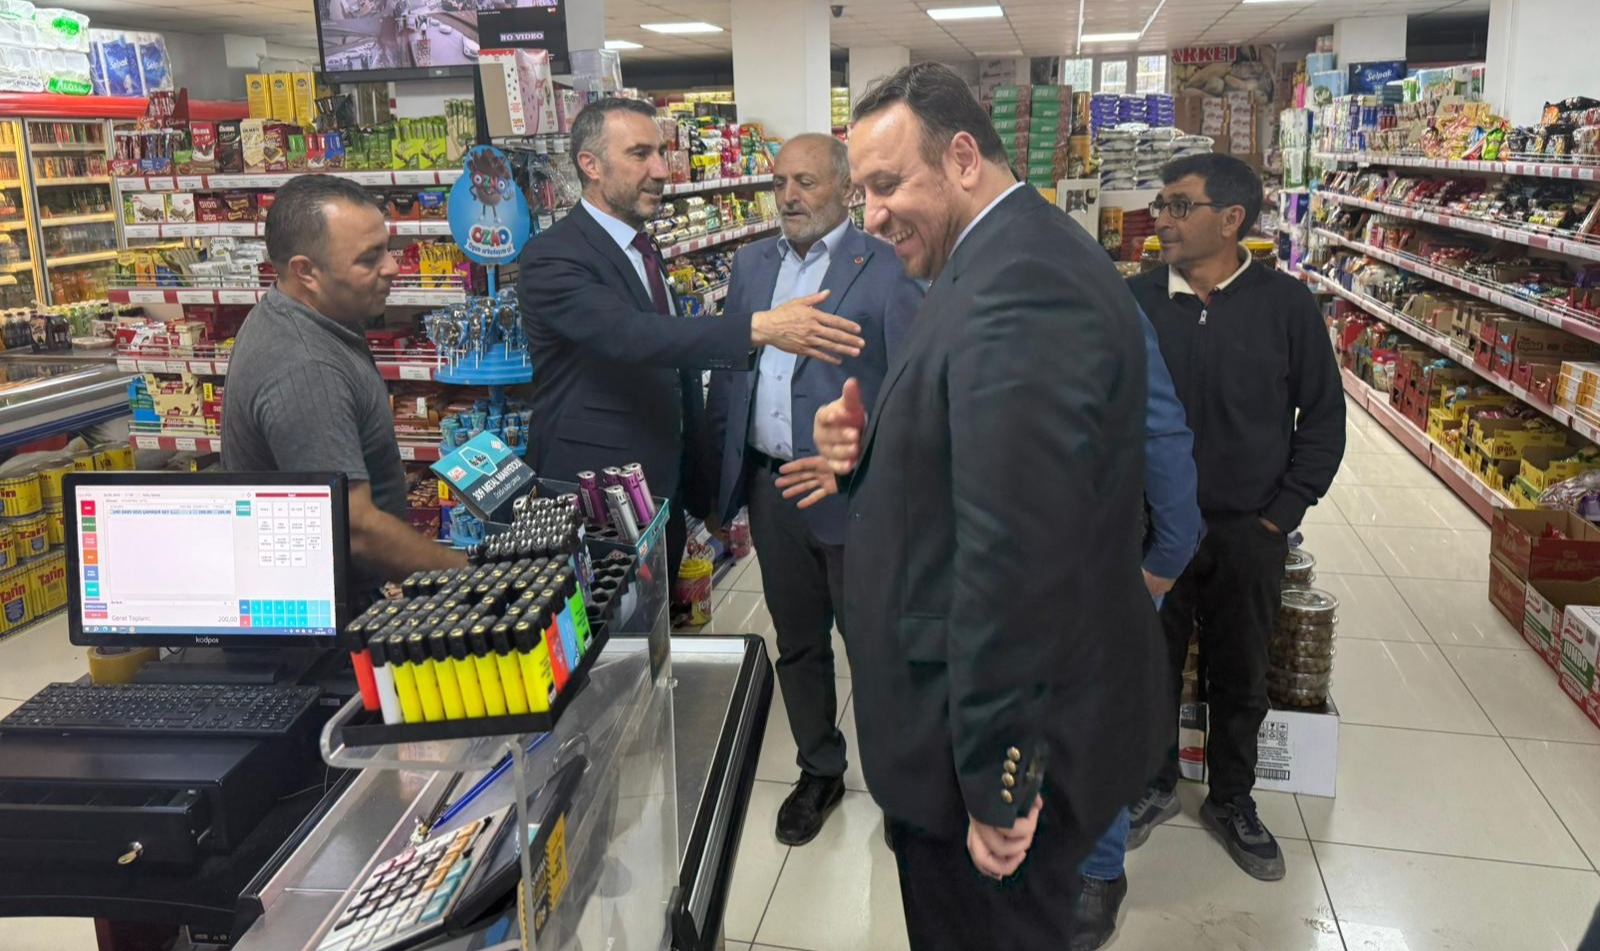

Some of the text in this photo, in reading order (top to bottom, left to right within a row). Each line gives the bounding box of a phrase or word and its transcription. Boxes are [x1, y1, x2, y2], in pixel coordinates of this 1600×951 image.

[500, 32, 544, 41] NO VIDEO
[1366, 69, 1393, 82] Selpak
[38, 566, 65, 585] Tarin
[195, 635, 219, 645] kodpos
[1563, 640, 1588, 672] JUMBO
